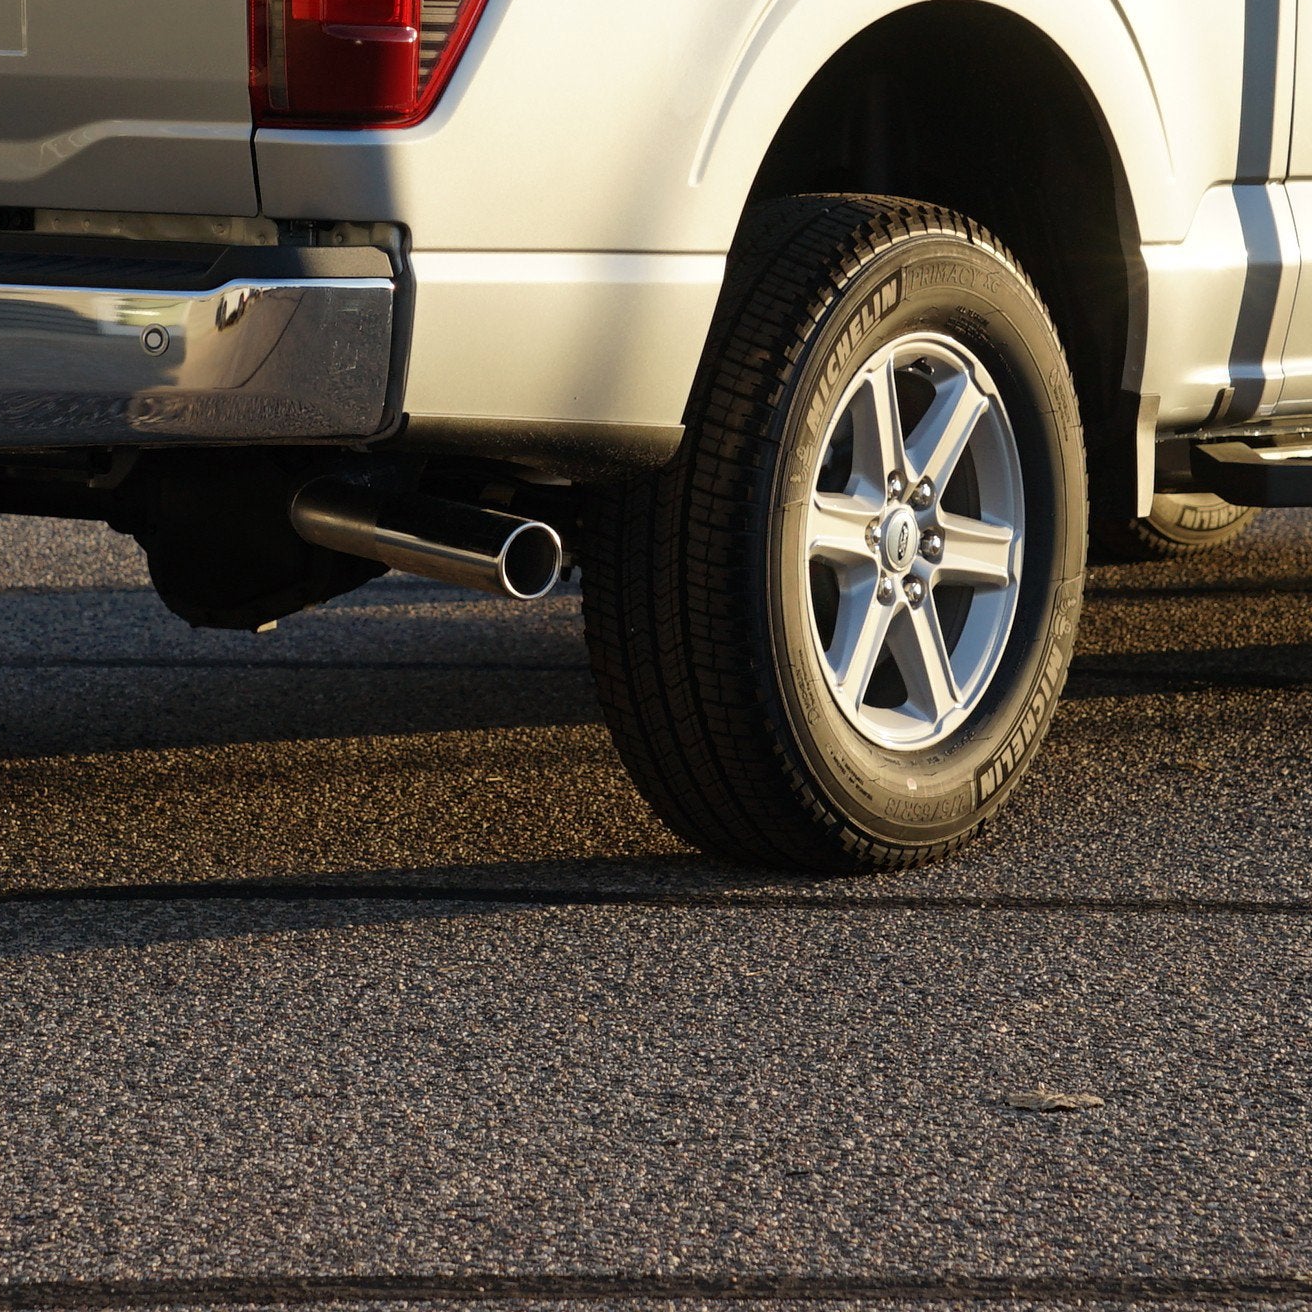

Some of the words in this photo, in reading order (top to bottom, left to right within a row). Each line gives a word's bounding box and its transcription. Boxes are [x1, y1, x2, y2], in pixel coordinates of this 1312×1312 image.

[806, 278, 898, 437] MICHELIN
[910, 263, 981, 289] PRIMACY
[979, 643, 1064, 802] MICHELIN
